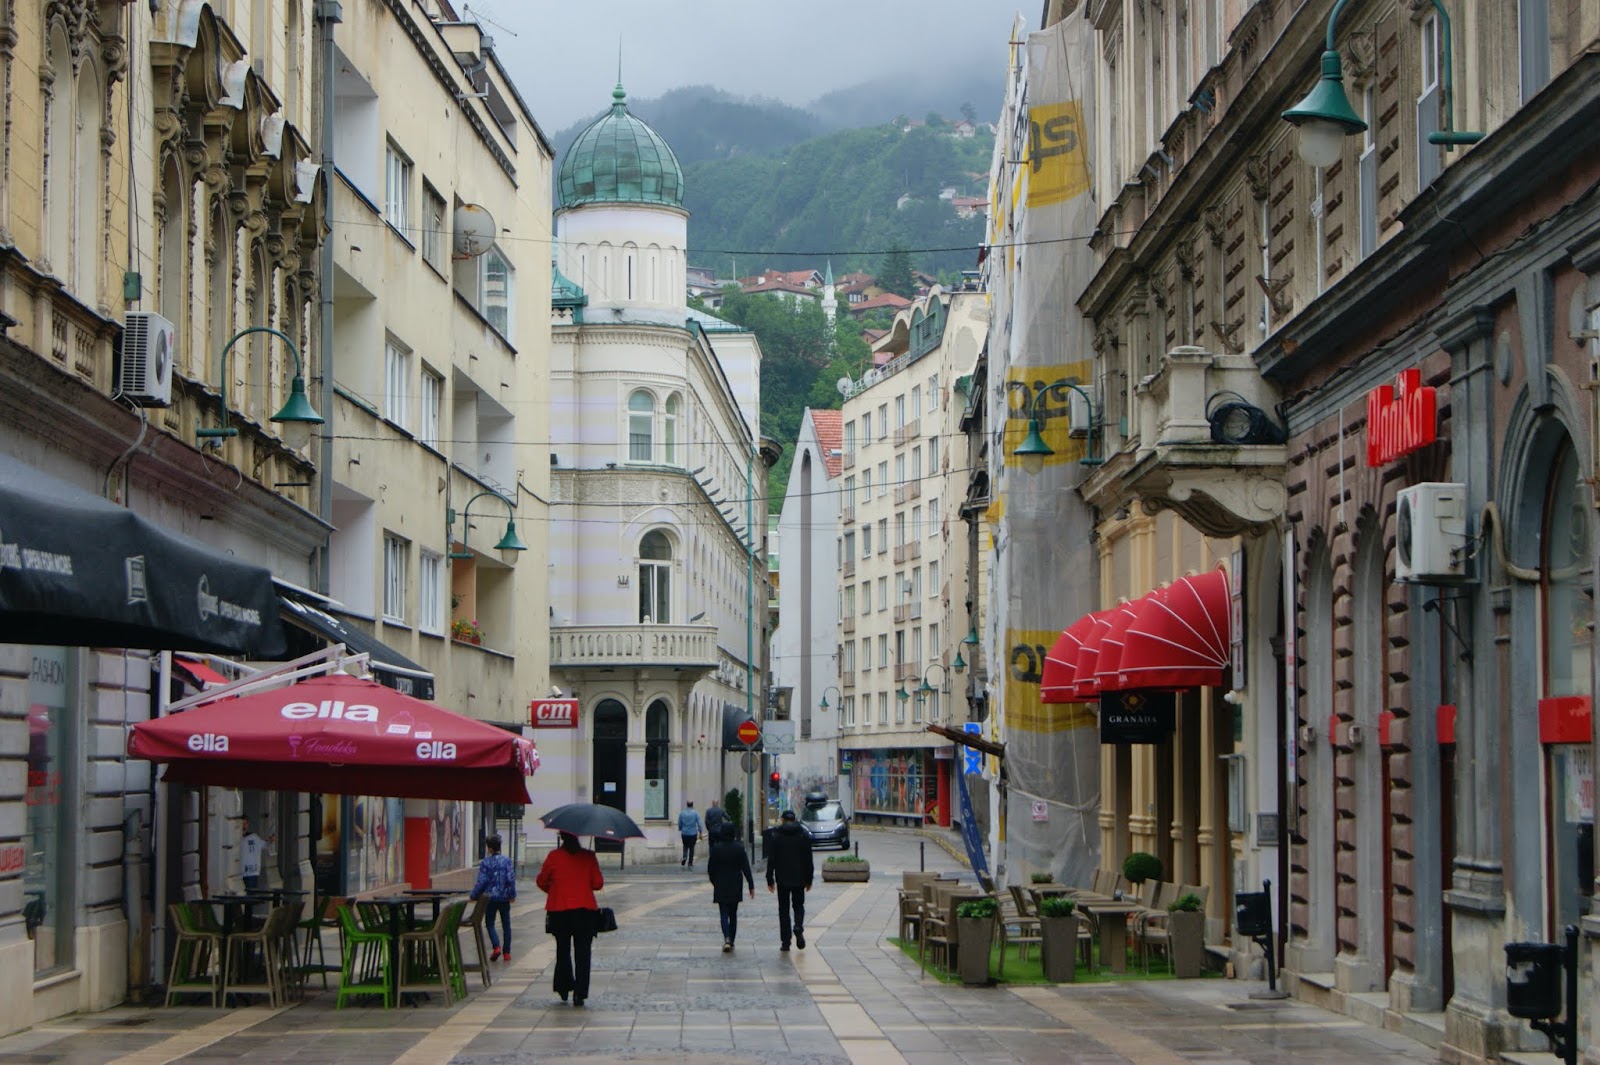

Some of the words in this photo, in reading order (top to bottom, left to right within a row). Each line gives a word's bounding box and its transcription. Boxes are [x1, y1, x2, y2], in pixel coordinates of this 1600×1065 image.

[32, 657, 65, 684] FASHION
[281, 700, 379, 722] ella
[537, 703, 572, 720] cm
[1109, 715, 1157, 723] GRANADA
[188, 733, 229, 752] ella
[416, 741, 457, 759] ella
